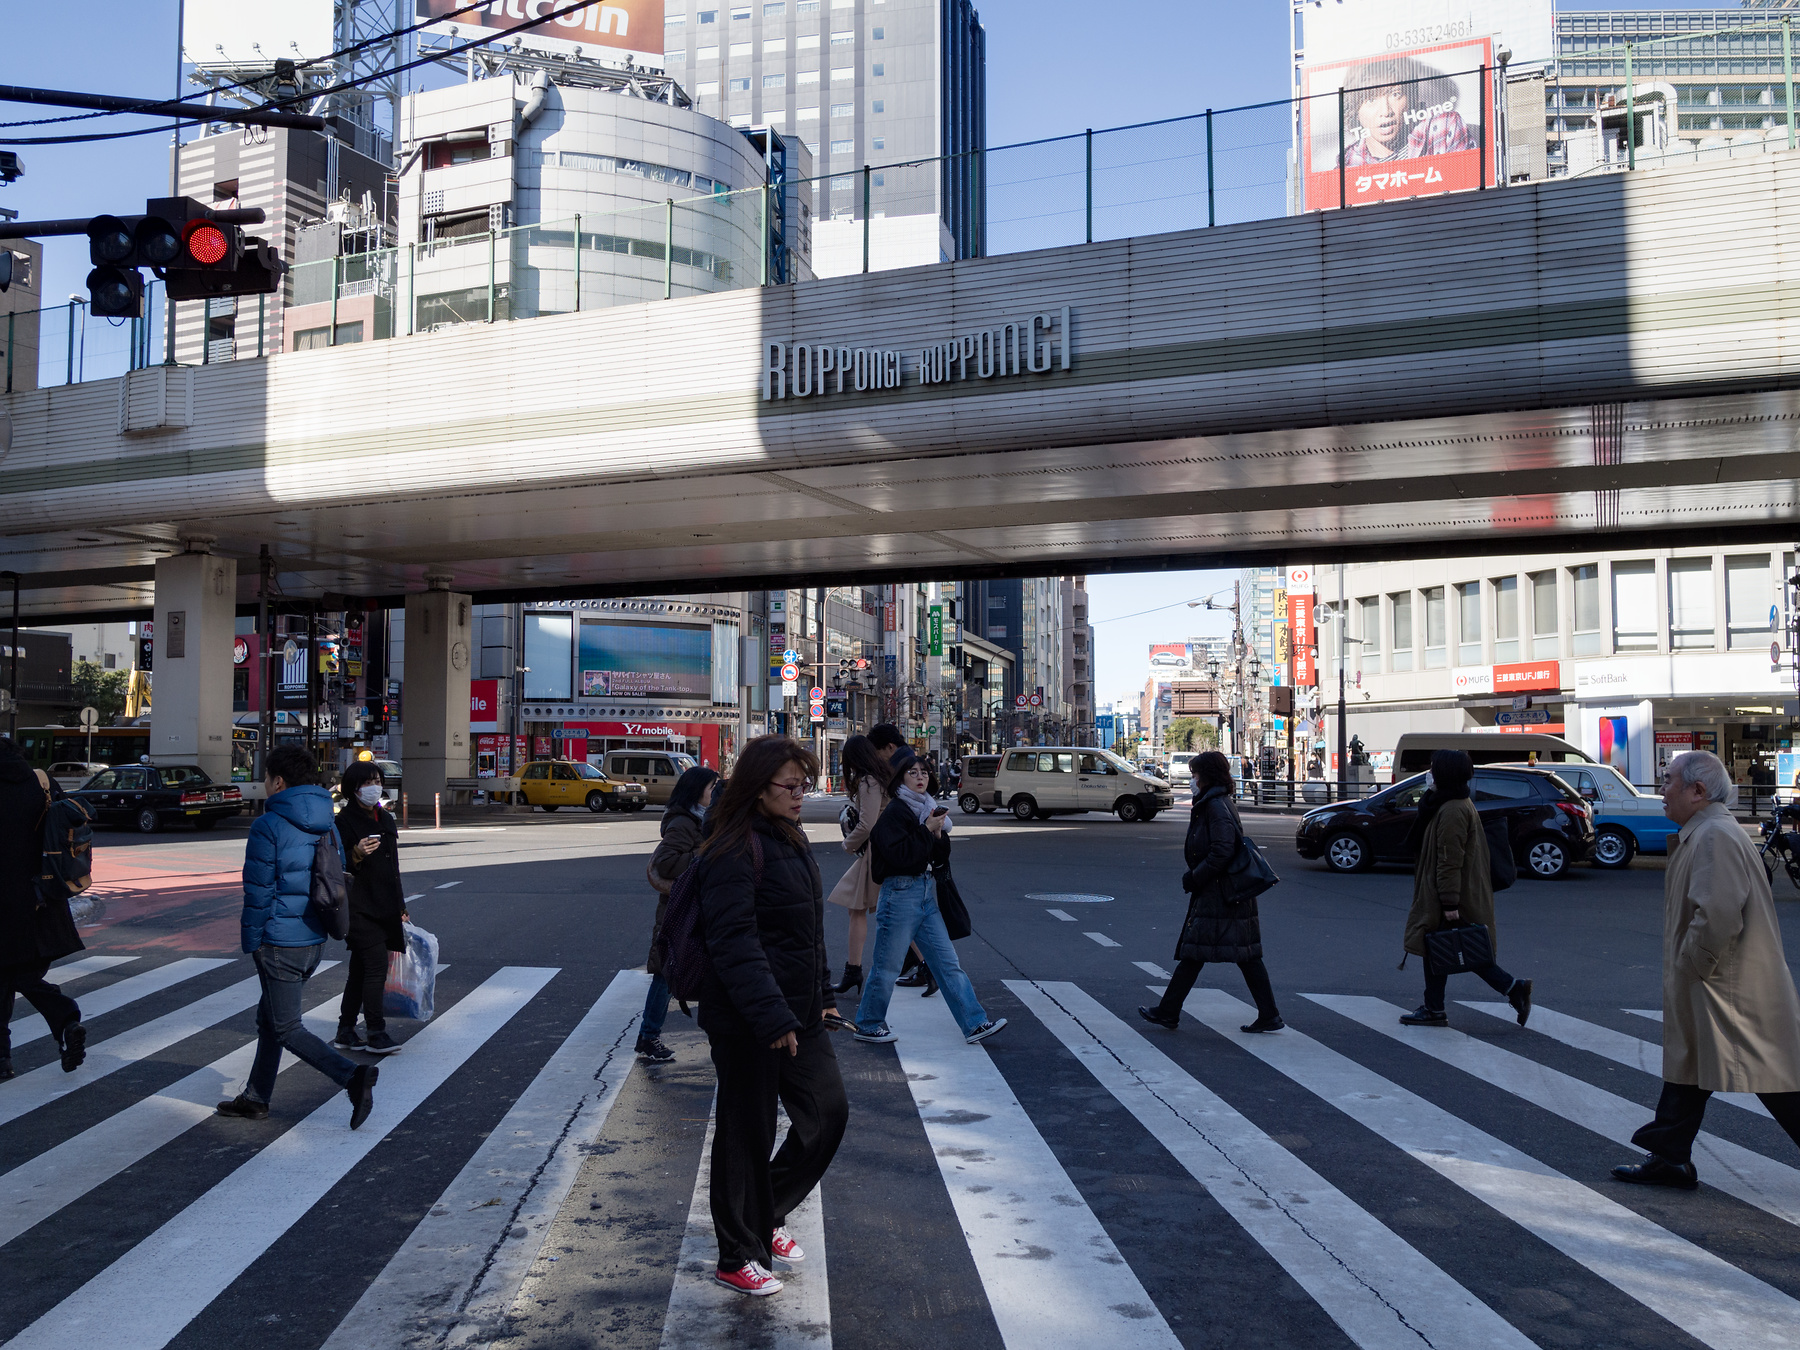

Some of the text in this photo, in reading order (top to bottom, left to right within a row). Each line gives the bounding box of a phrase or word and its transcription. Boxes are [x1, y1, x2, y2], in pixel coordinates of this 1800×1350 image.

[455, 0, 630, 36] tcoin
[1386, 20, 1465, 49] 03-53372468
[1403, 103, 1455, 126] Home
[1355, 166, 1443, 193] タマホーム
[612, 671, 671, 680] ヤバイTシャツ屋さん
[1468, 675, 1490, 684] MUFG
[1496, 670, 1551, 683] 三菱東京UFJ銀行
[1590, 673, 1628, 684] SoftBank
[471, 697, 487, 711] ile
